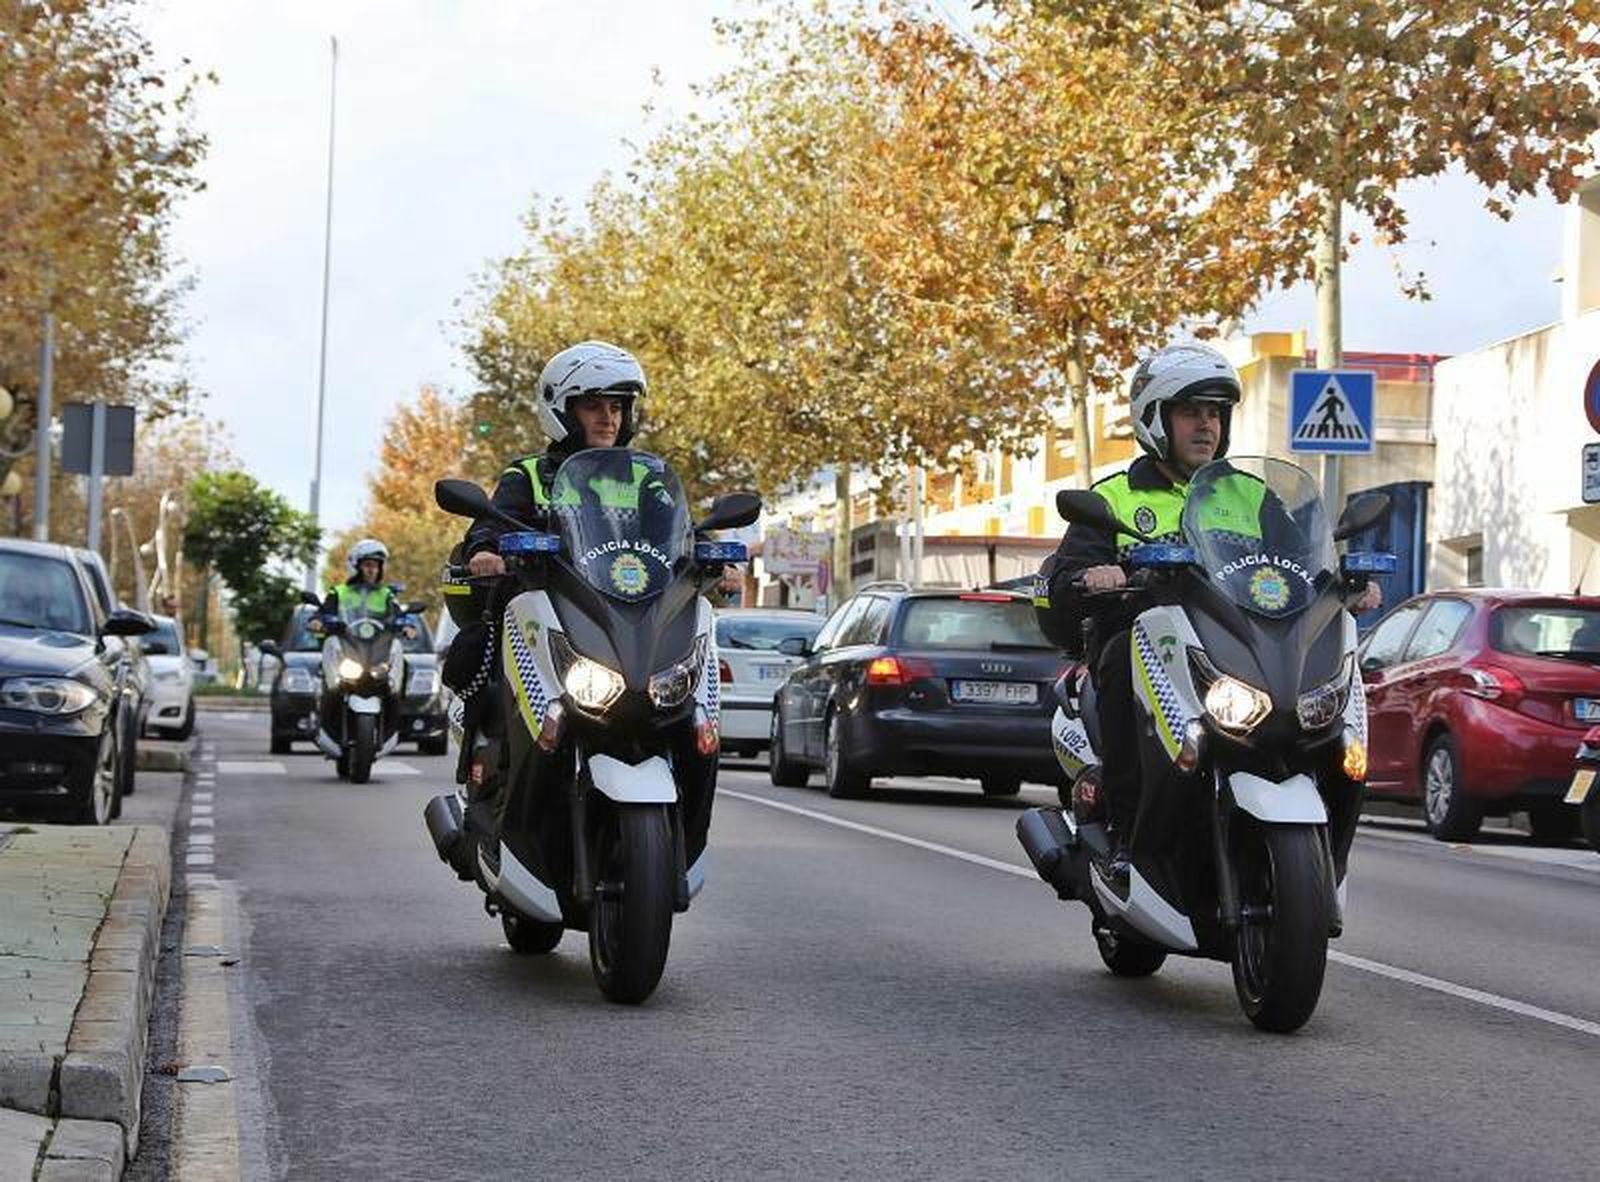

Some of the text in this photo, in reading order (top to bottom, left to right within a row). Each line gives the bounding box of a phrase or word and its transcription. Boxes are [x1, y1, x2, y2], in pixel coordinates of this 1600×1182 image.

[580, 539, 672, 569] POLICIA LOCAL
[1215, 554, 1314, 586] POLICIA LOCAL
